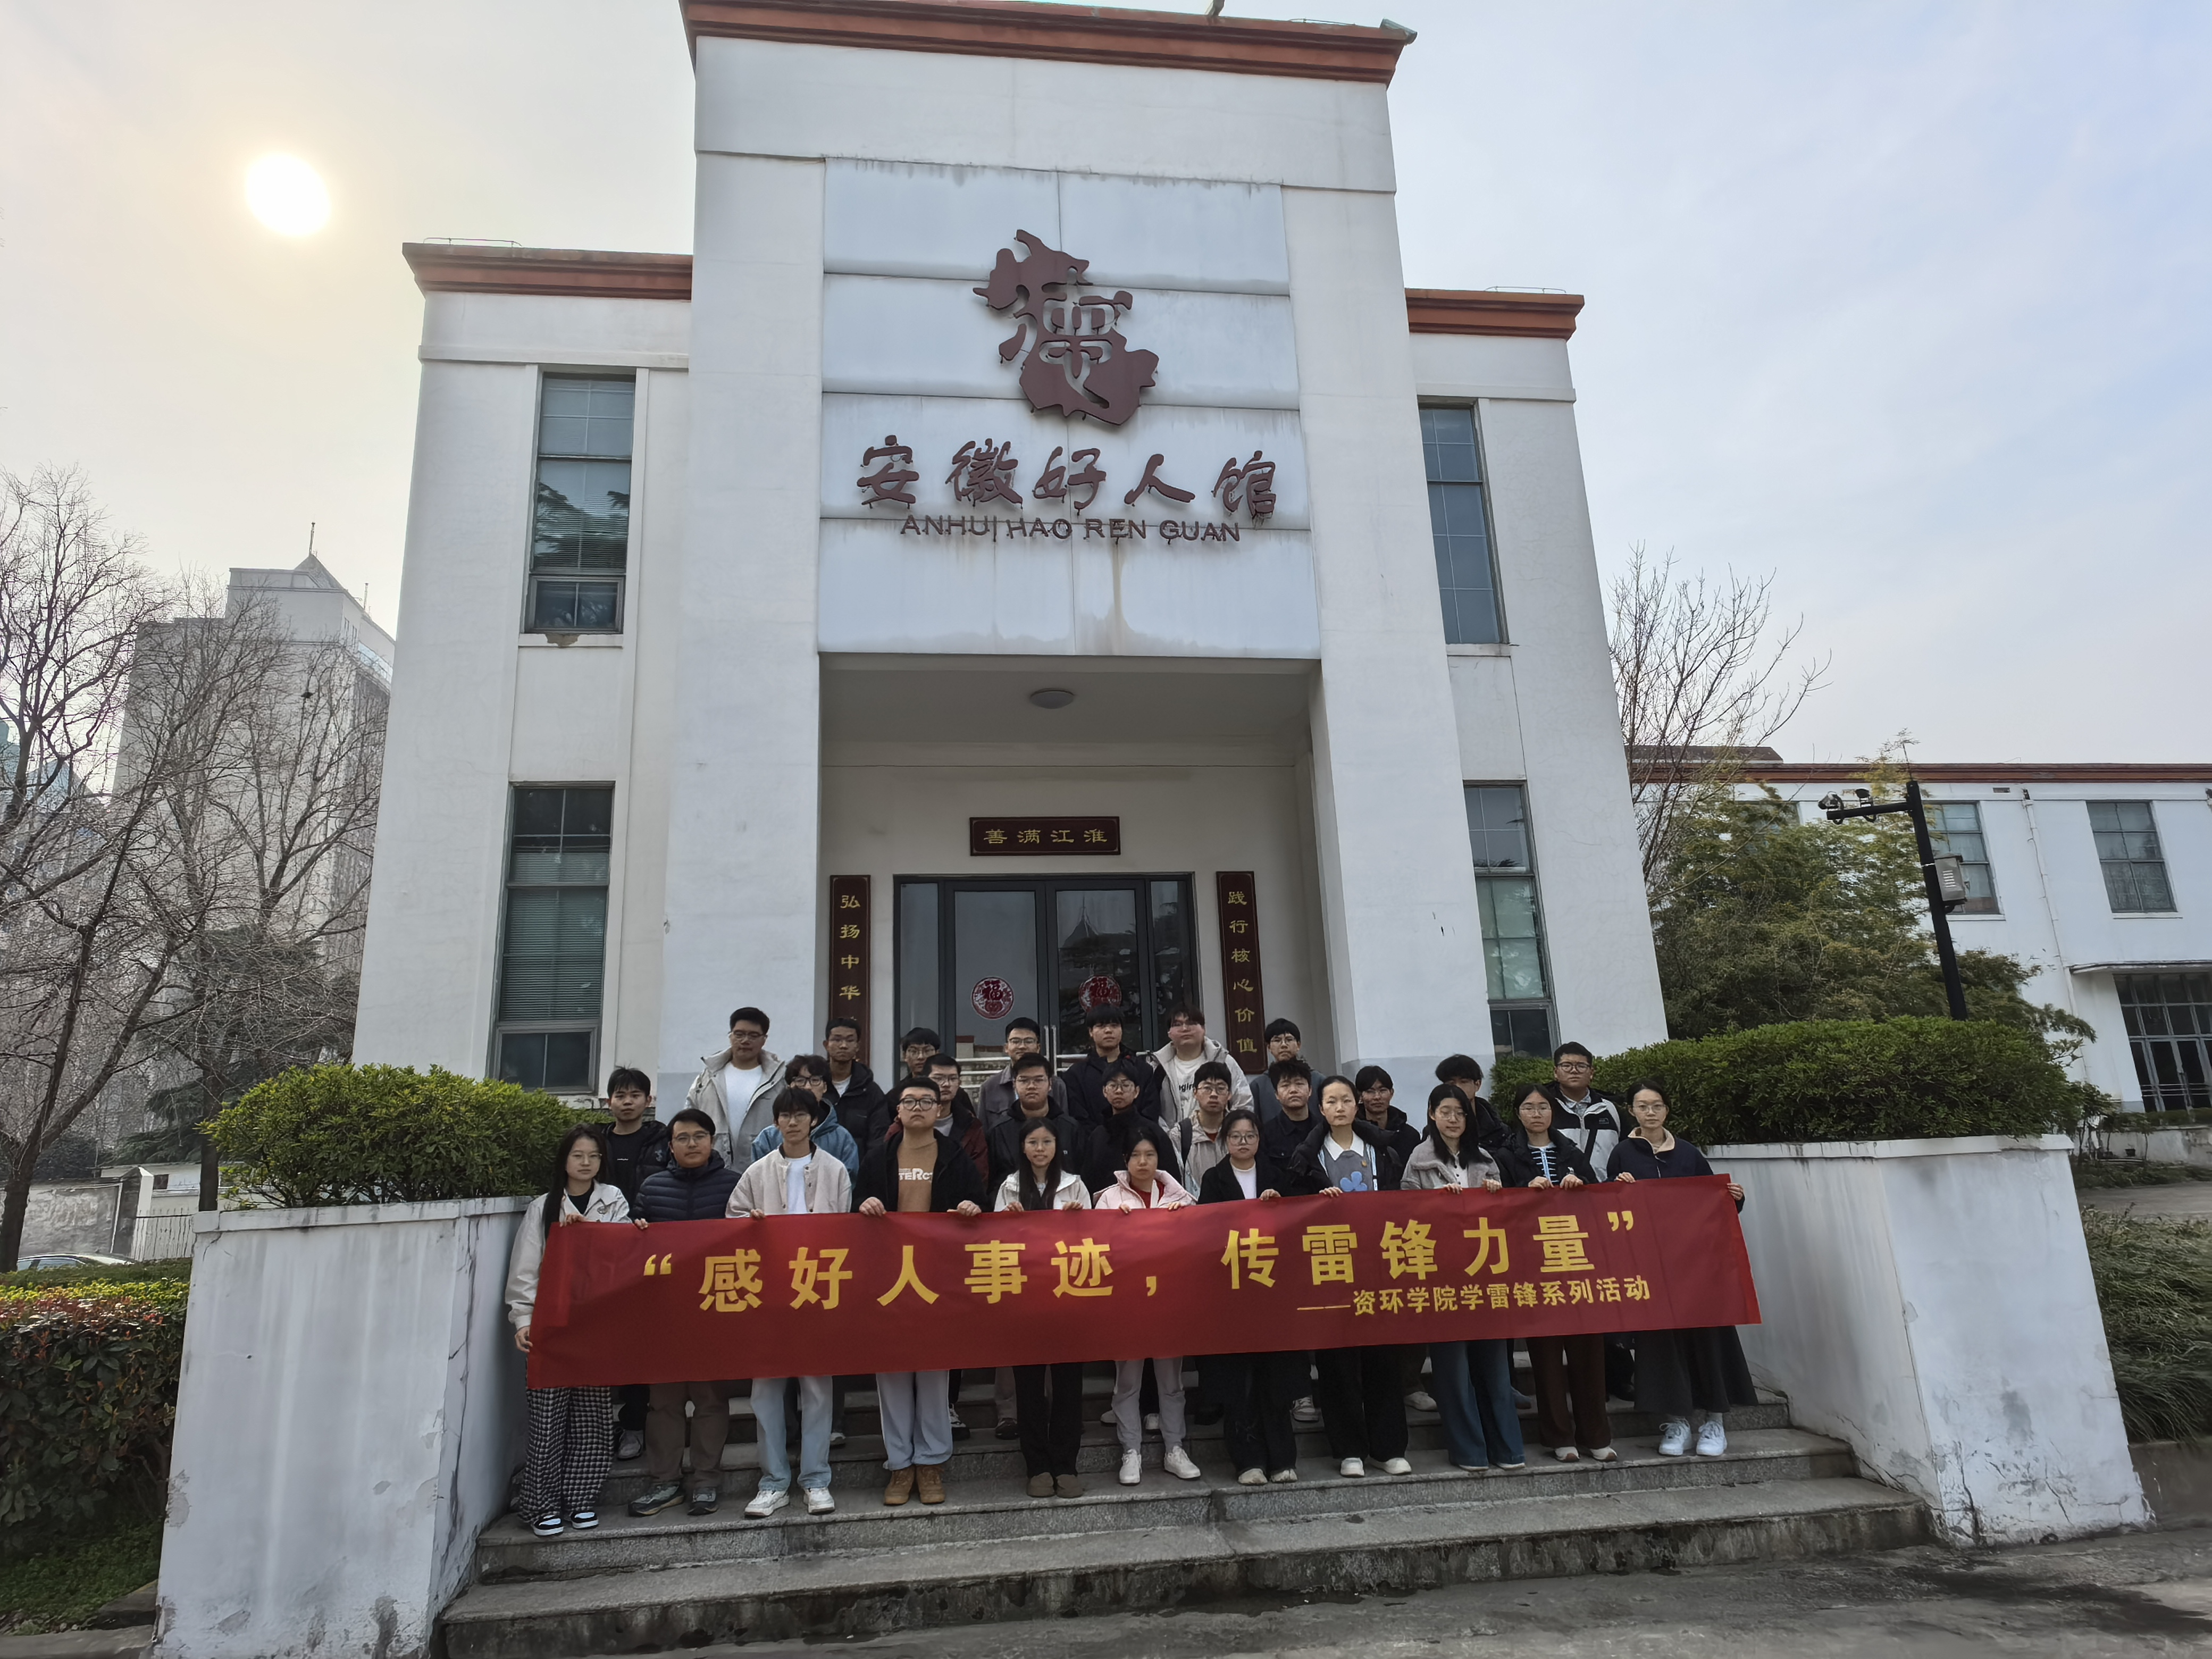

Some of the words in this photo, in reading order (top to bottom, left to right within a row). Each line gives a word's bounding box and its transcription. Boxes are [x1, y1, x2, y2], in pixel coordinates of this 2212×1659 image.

[857, 435, 1276, 518] 安徽好人馆
[901, 515, 998, 538] ANHUI
[1007, 517, 1074, 540] HAO
[1083, 518, 1147, 541] REN
[1158, 520, 1241, 543] GUAN
[983, 829, 1108, 844] 善满江淮
[839, 895, 861, 1021] 弘扬中华
[1227, 891, 1258, 1053] 践行核心价值
[643, 1210, 1635, 1312] “感好人事迹，传雷锋力量”
